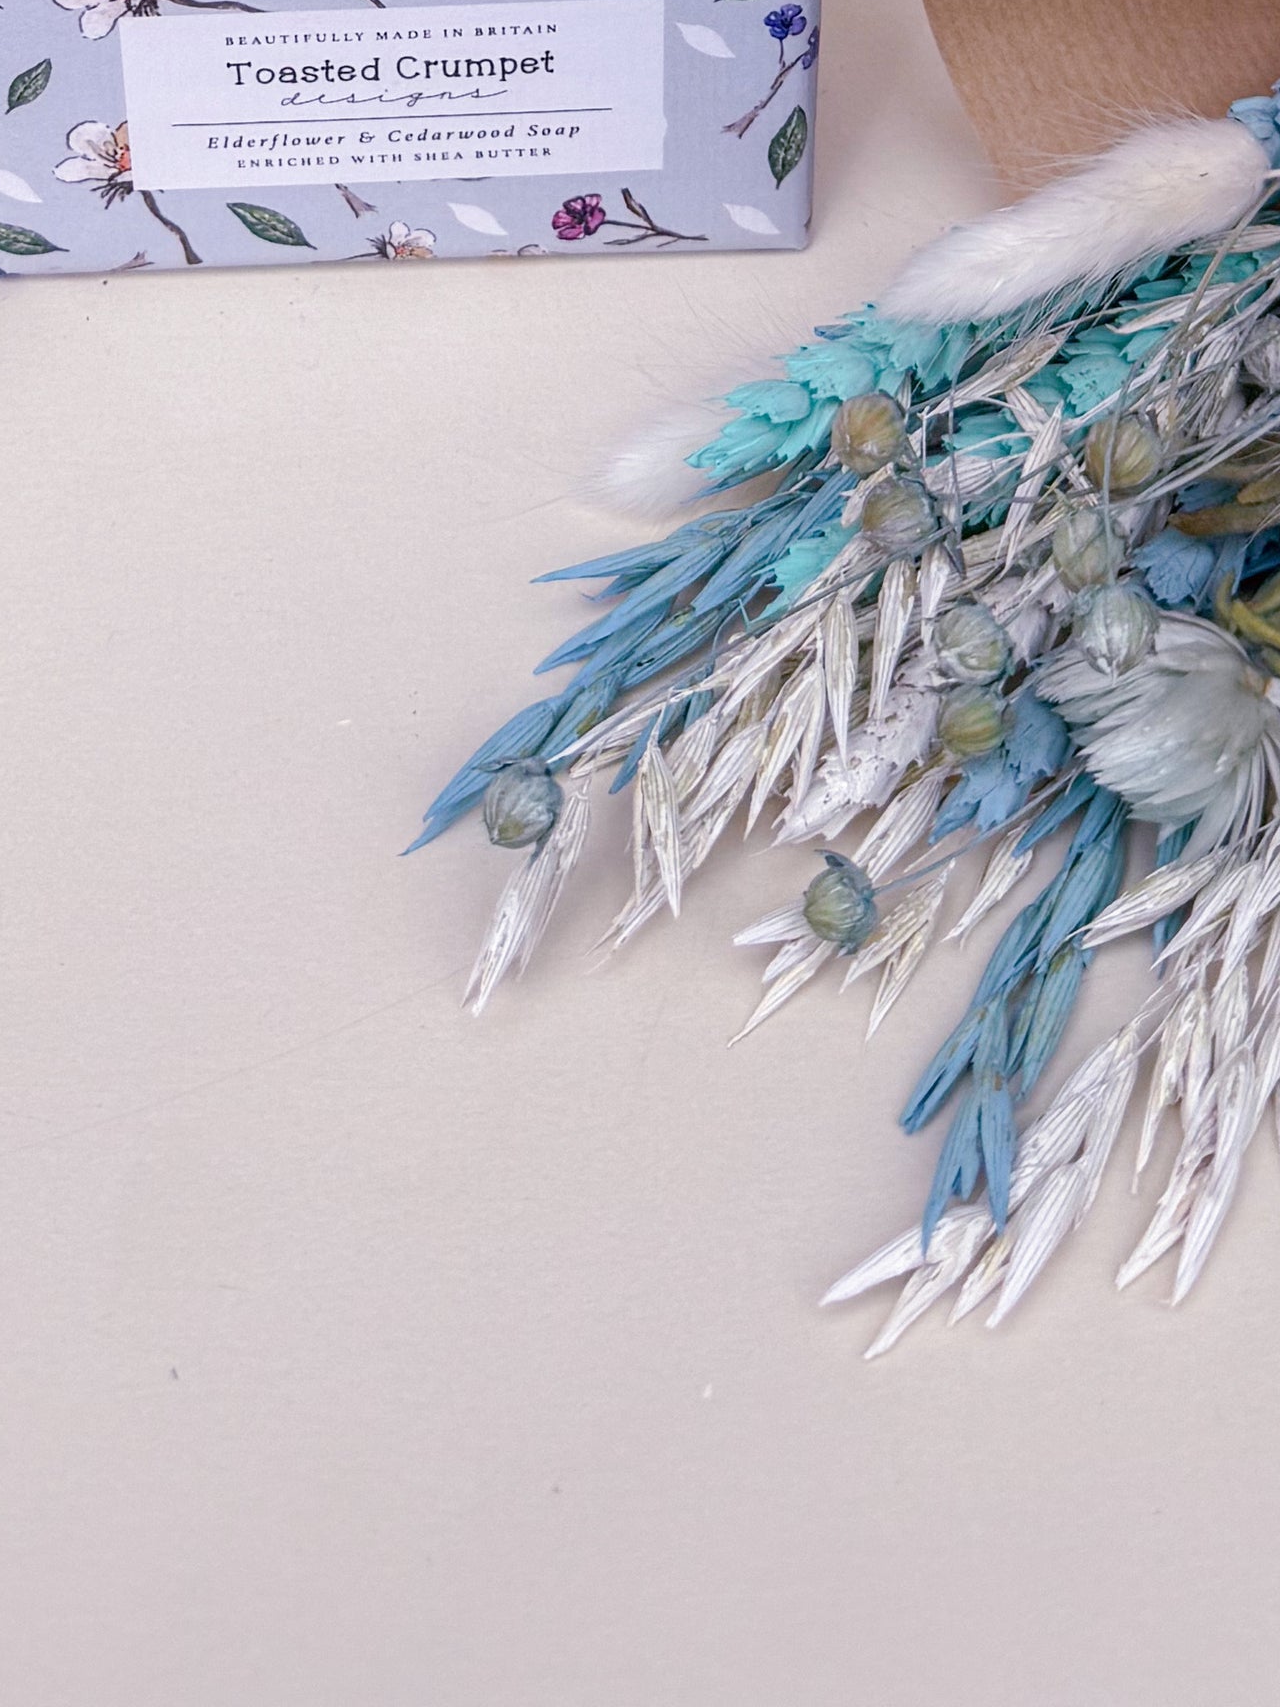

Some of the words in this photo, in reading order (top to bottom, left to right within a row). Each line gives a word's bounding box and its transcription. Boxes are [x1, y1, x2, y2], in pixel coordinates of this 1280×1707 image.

[225, 31, 364, 46] BEAUTIFULLY
[376, 29, 432, 41] MADE
[443, 27, 463, 38] IN
[474, 23, 558, 36] BRITAIN
[227, 58, 380, 85] Toasted
[396, 50, 555, 83] Crumpet
[208, 133, 346, 150] Elderflower
[359, 131, 375, 144] &
[388, 125, 516, 143] Cedarwood
[527, 123, 580, 138] Soap
[237, 155, 340, 168] ENRICHED
[351, 154, 404, 164] WITH
[414, 151, 464, 162] SHEA
[476, 148, 553, 160] BUTTER
